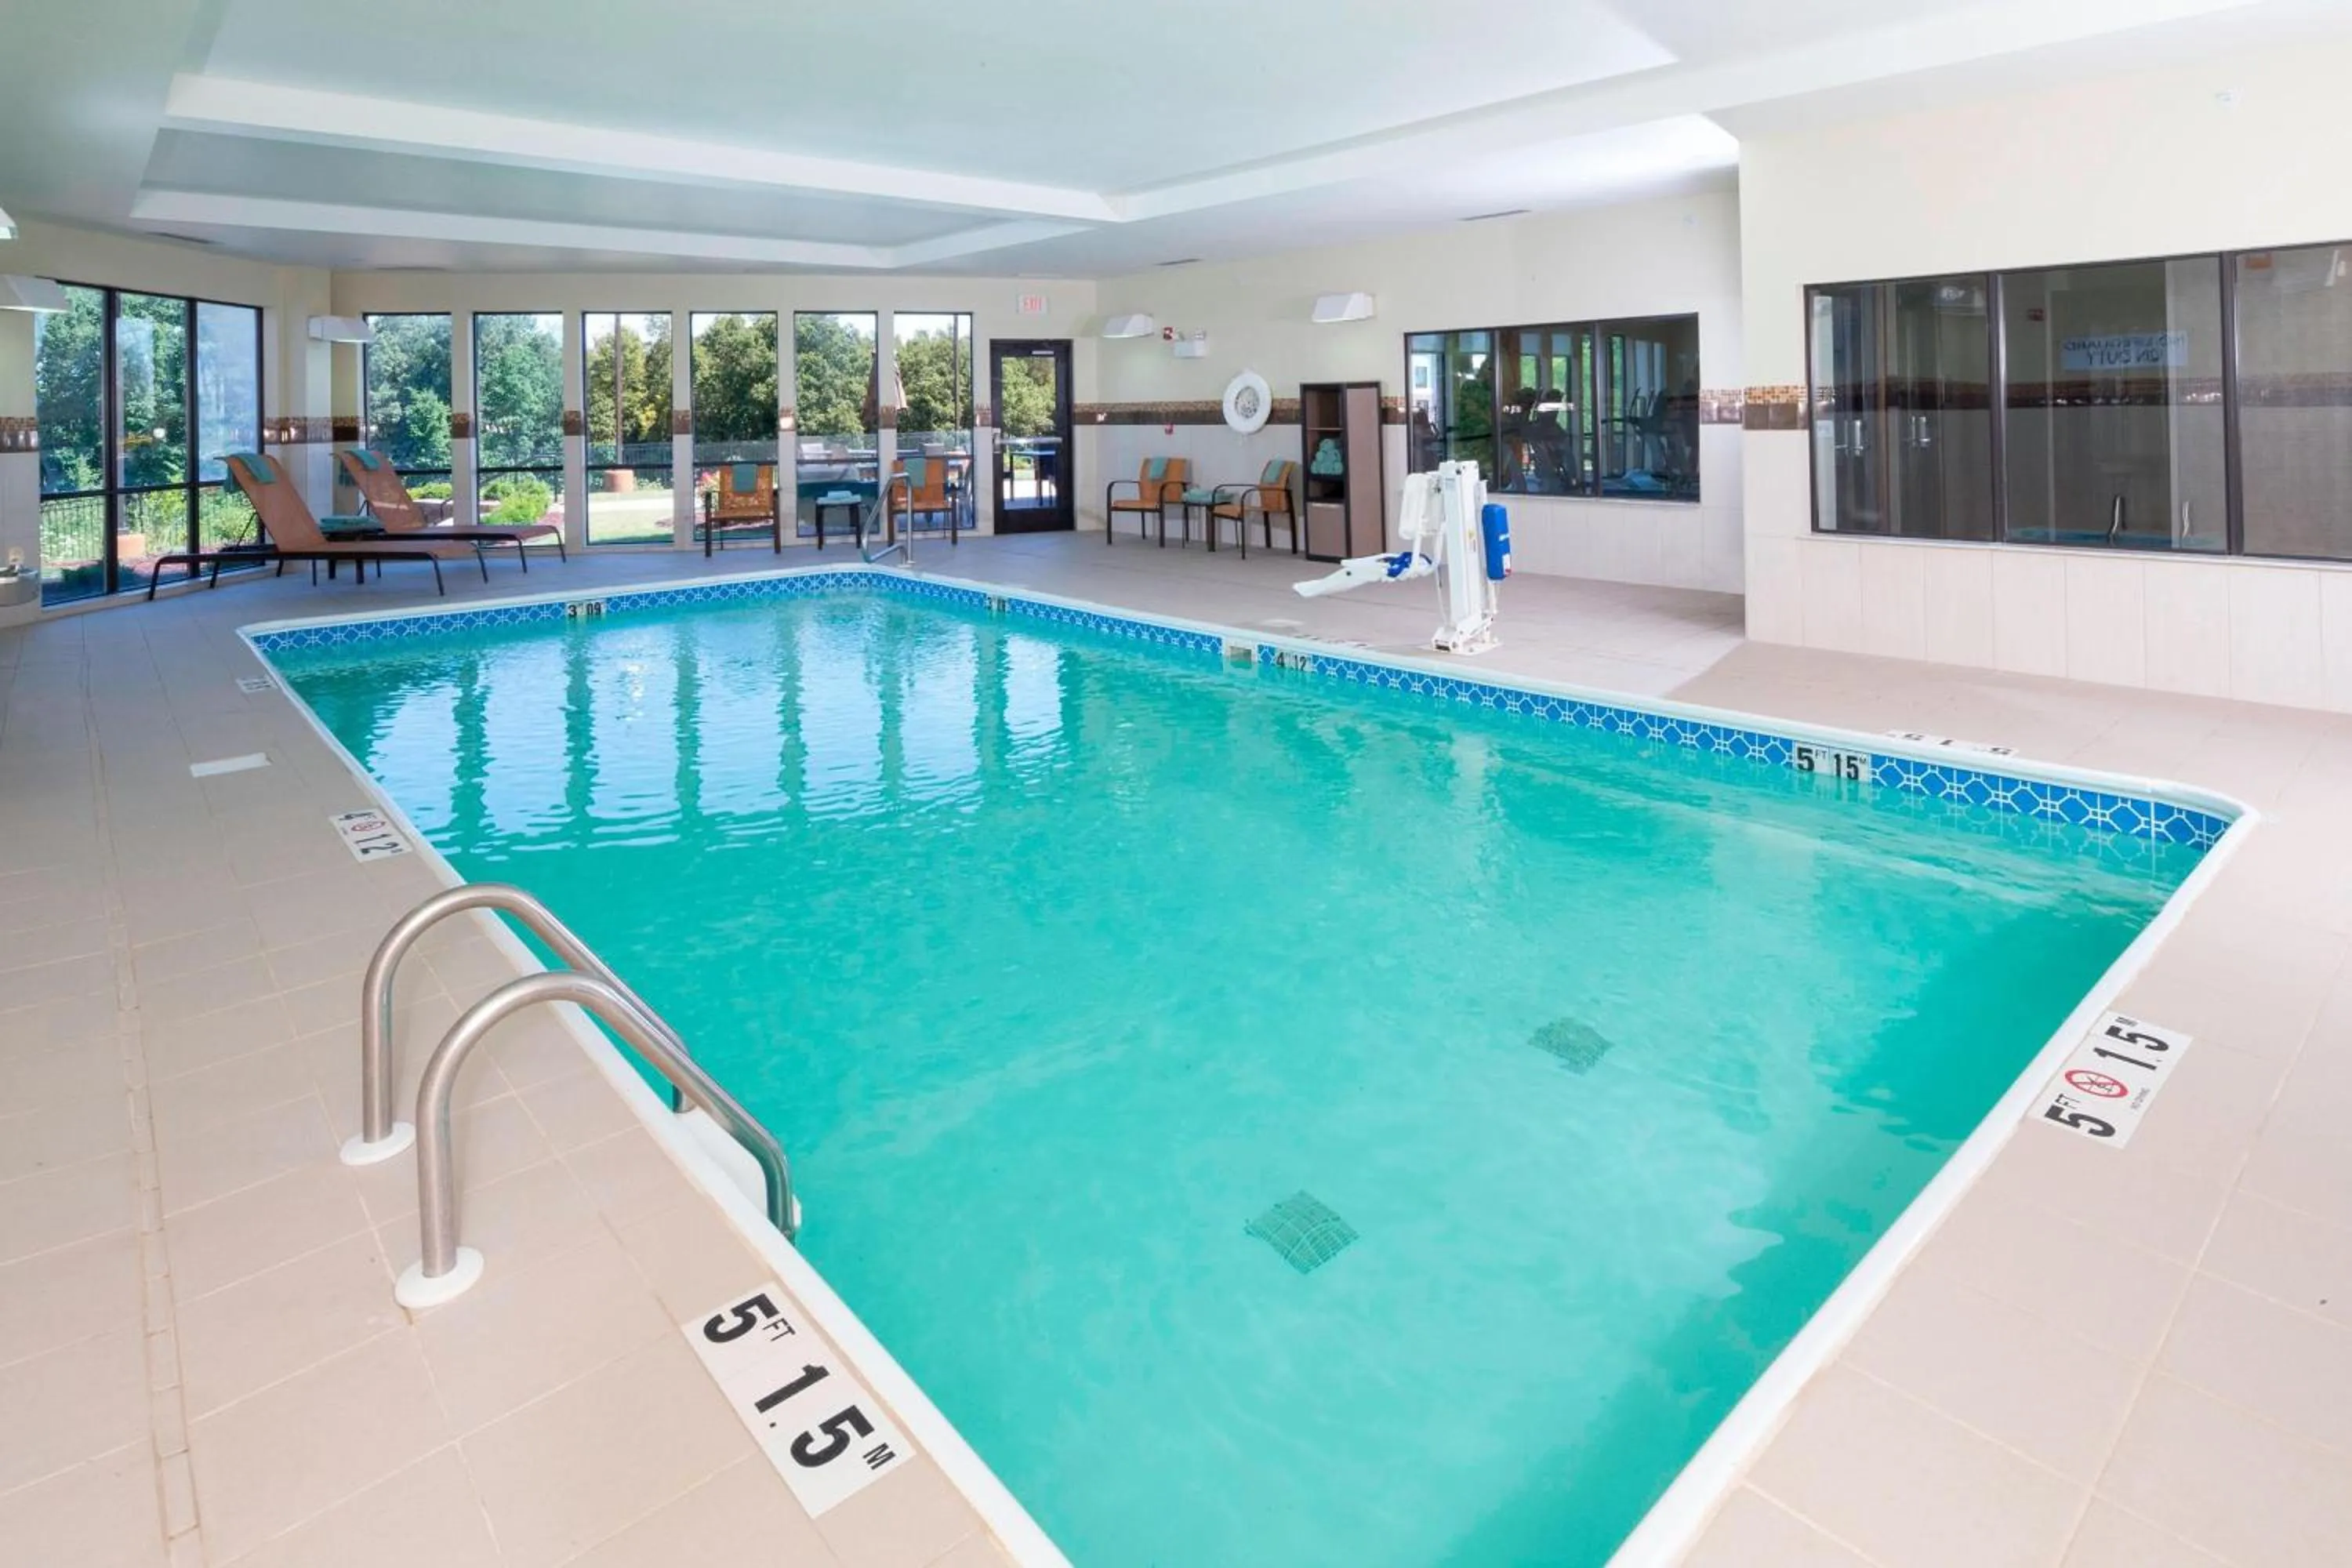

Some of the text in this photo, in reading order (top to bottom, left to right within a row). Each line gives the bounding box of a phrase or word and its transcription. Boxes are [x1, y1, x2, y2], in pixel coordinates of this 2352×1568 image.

[568, 604, 578, 618] 3
[1796, 746, 1815, 772] 5
[2044, 1105, 2117, 1138] 5
[703, 1293, 896, 1470] 5 FT 1.5 M
